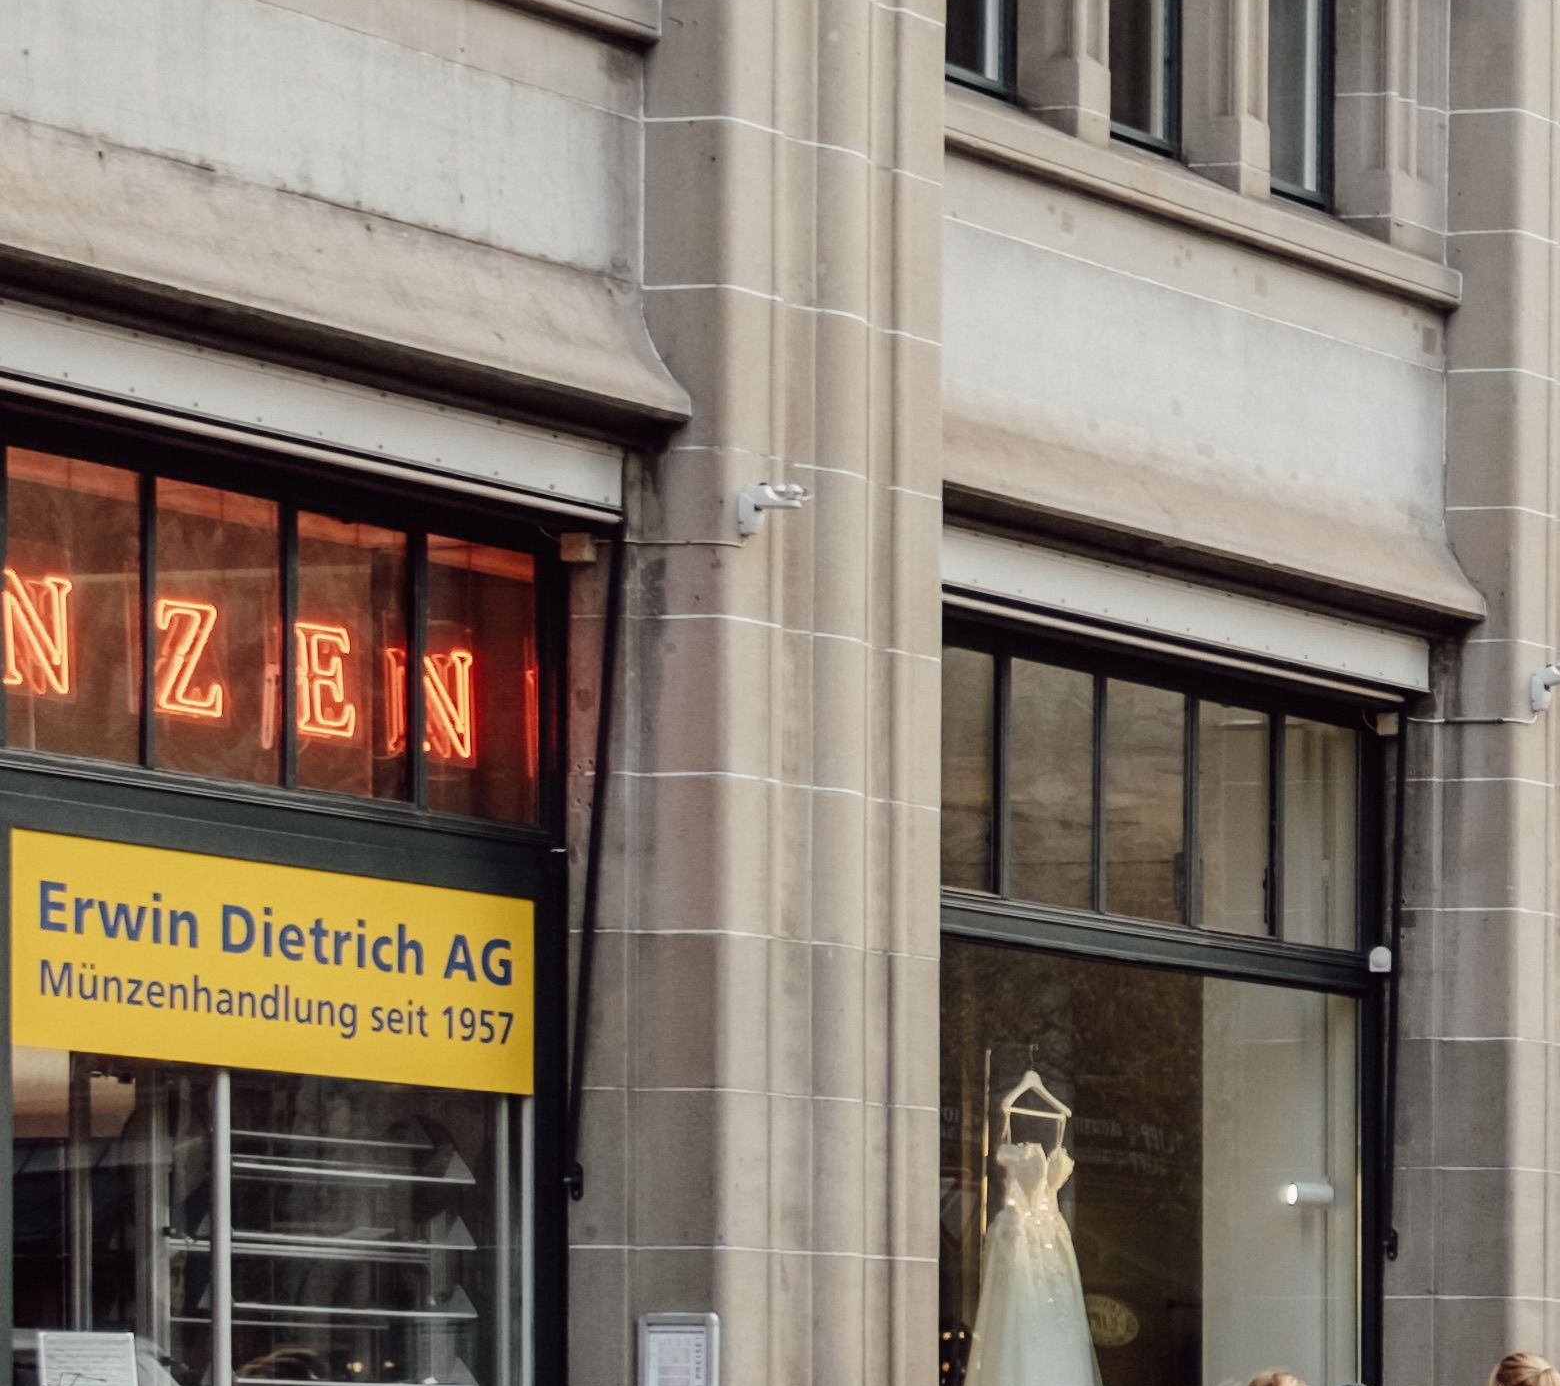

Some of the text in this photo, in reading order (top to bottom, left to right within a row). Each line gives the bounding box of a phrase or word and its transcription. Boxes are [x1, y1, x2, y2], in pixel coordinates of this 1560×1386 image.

[39, 880, 512, 986] Erwin Dietrich AG
[40, 959, 514, 1045] Münzenhandlung seit 1957
